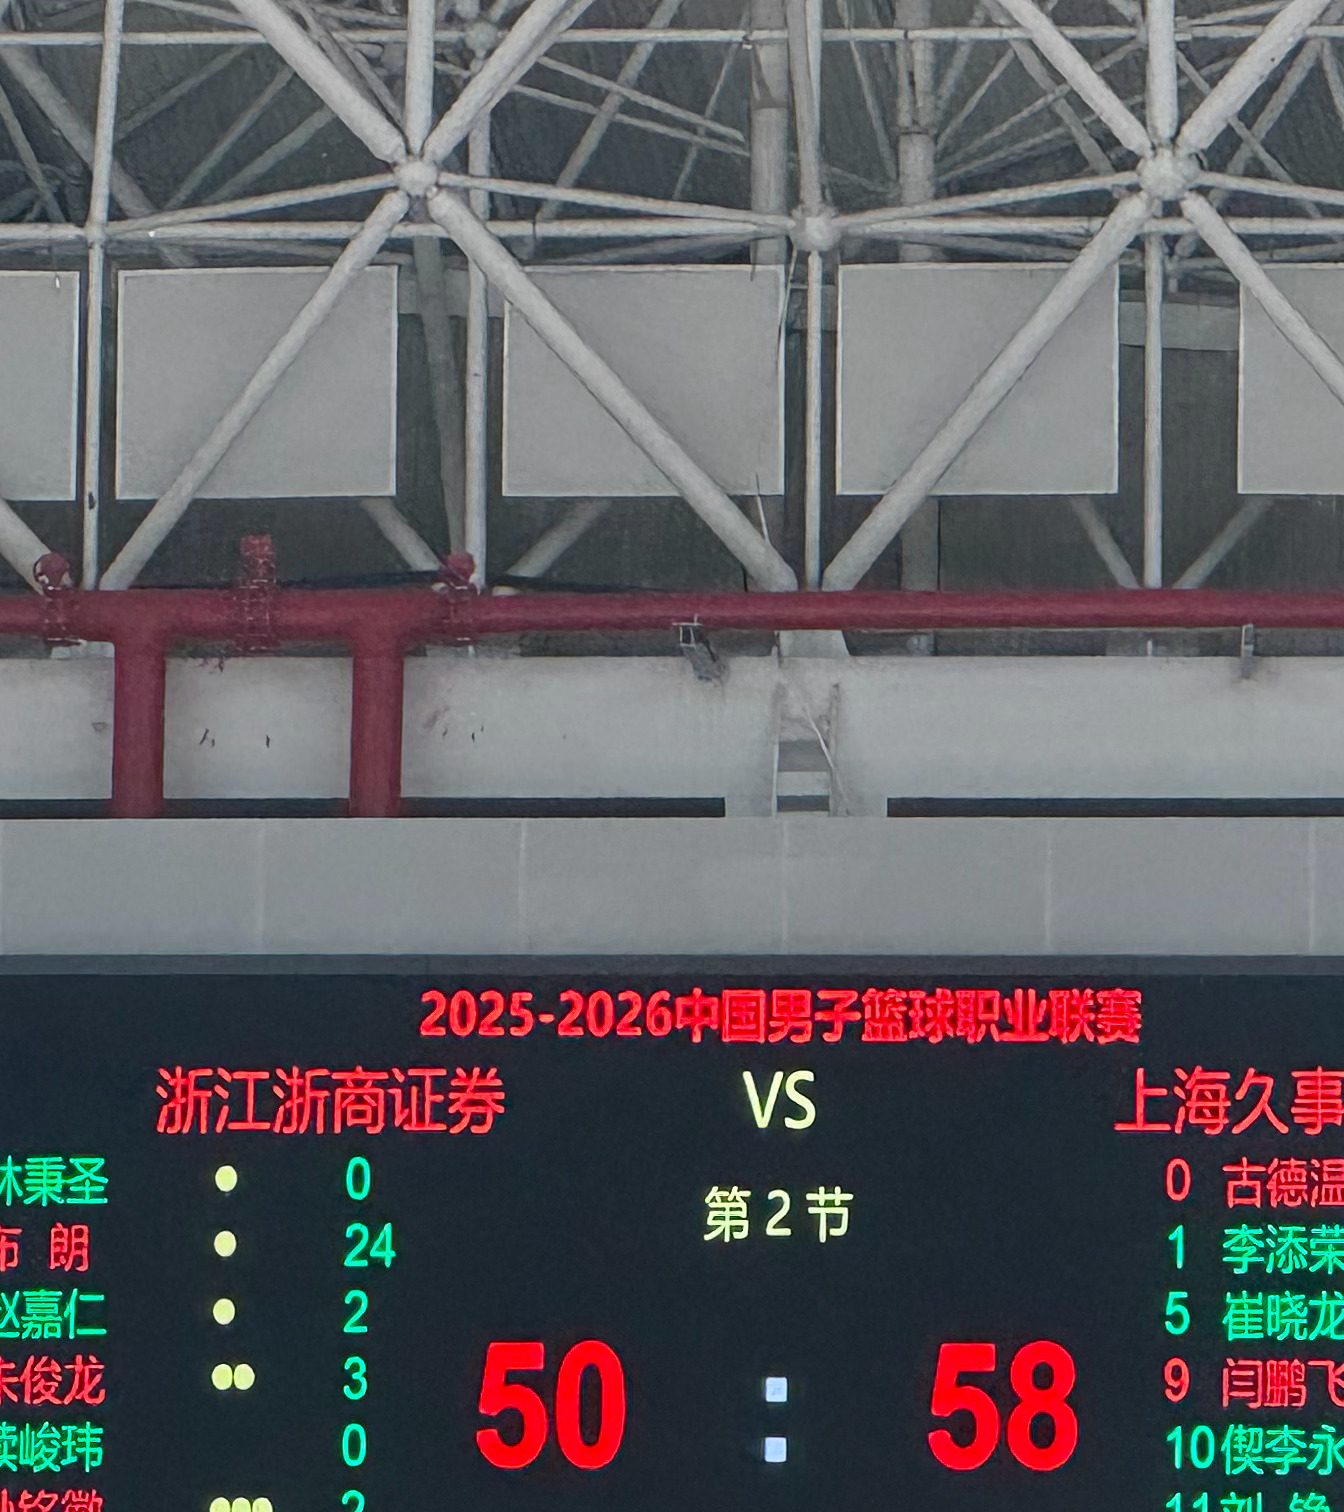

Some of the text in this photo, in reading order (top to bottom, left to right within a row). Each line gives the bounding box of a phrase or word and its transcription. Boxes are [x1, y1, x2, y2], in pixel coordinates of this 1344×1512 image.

[419, 987, 1143, 1045] 2025-2026中国男子篮球职业联赛
[155, 1065, 506, 1135] 浙江浙商证券
[742, 1070, 816, 1130] VS
[346, 1157, 370, 1200] 0
[1166, 1158, 1191, 1202] 0
[344, 1223, 396, 1268] 24
[1168, 1225, 1183, 1269] 1
[343, 1290, 368, 1333] 2
[1165, 1291, 1190, 1335] 5
[344, 1356, 367, 1400] 3
[1164, 1358, 1190, 1402] 9
[475, 1339, 627, 1471] 50
[927, 1339, 1079, 1472] 58
[342, 1423, 366, 1466] 0
